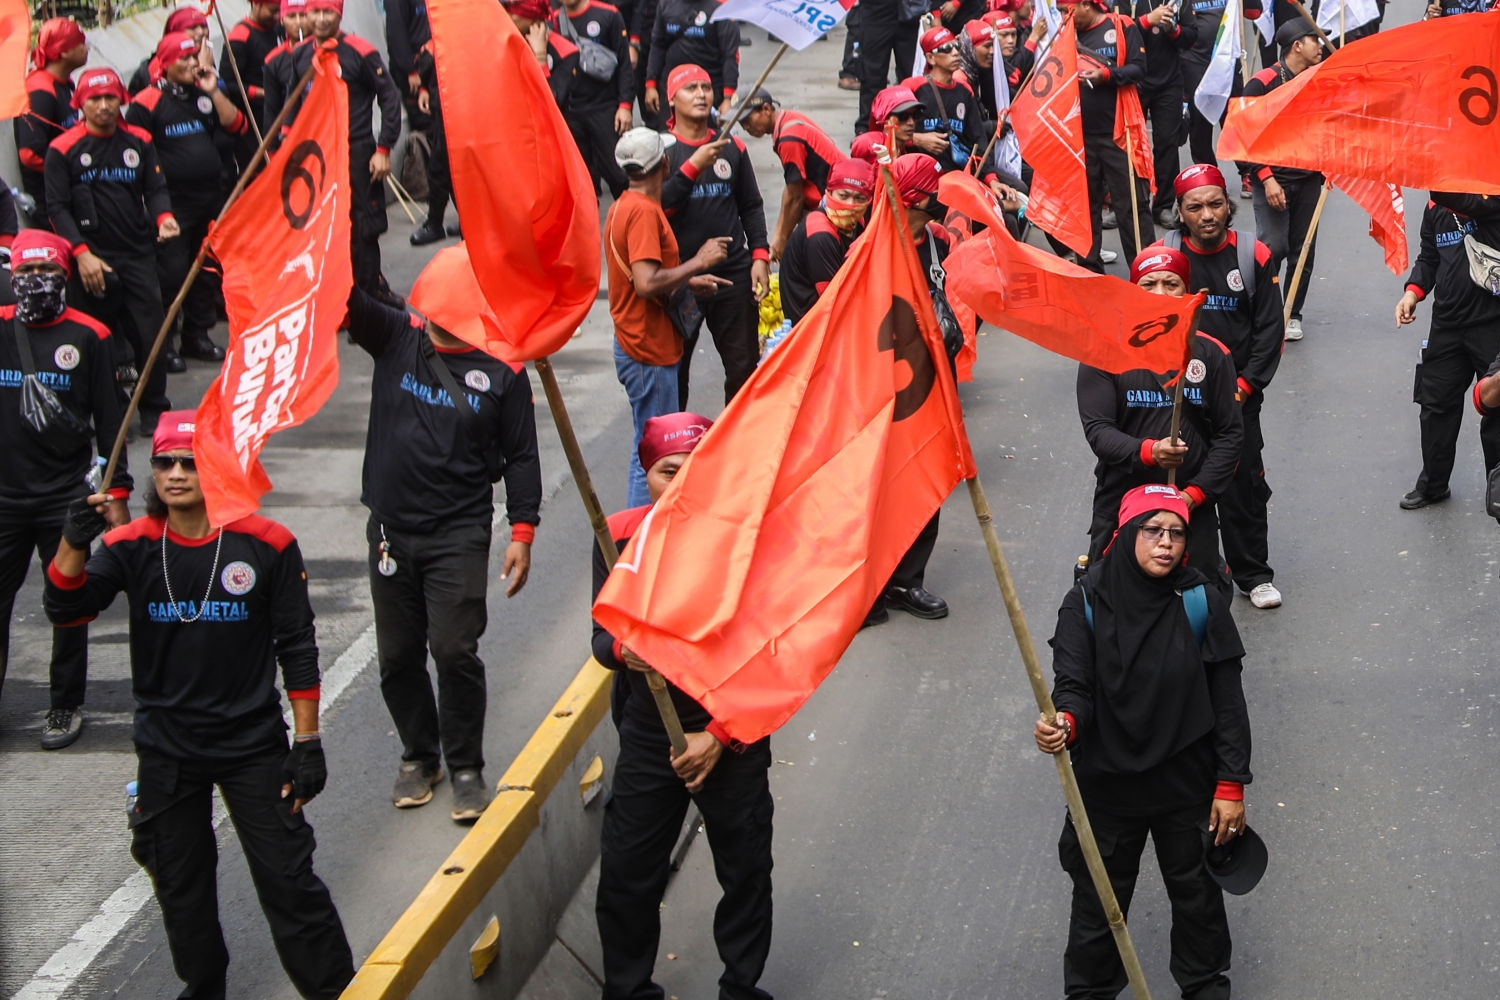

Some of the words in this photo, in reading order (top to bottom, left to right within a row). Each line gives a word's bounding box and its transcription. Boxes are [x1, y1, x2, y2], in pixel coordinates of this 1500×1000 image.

[1030, 56, 1064, 99] 6
[281, 139, 326, 231] 6
[1127, 389, 1163, 402] GARDA
[148, 601, 196, 618] GARDA
[201, 601, 249, 617] METAL
